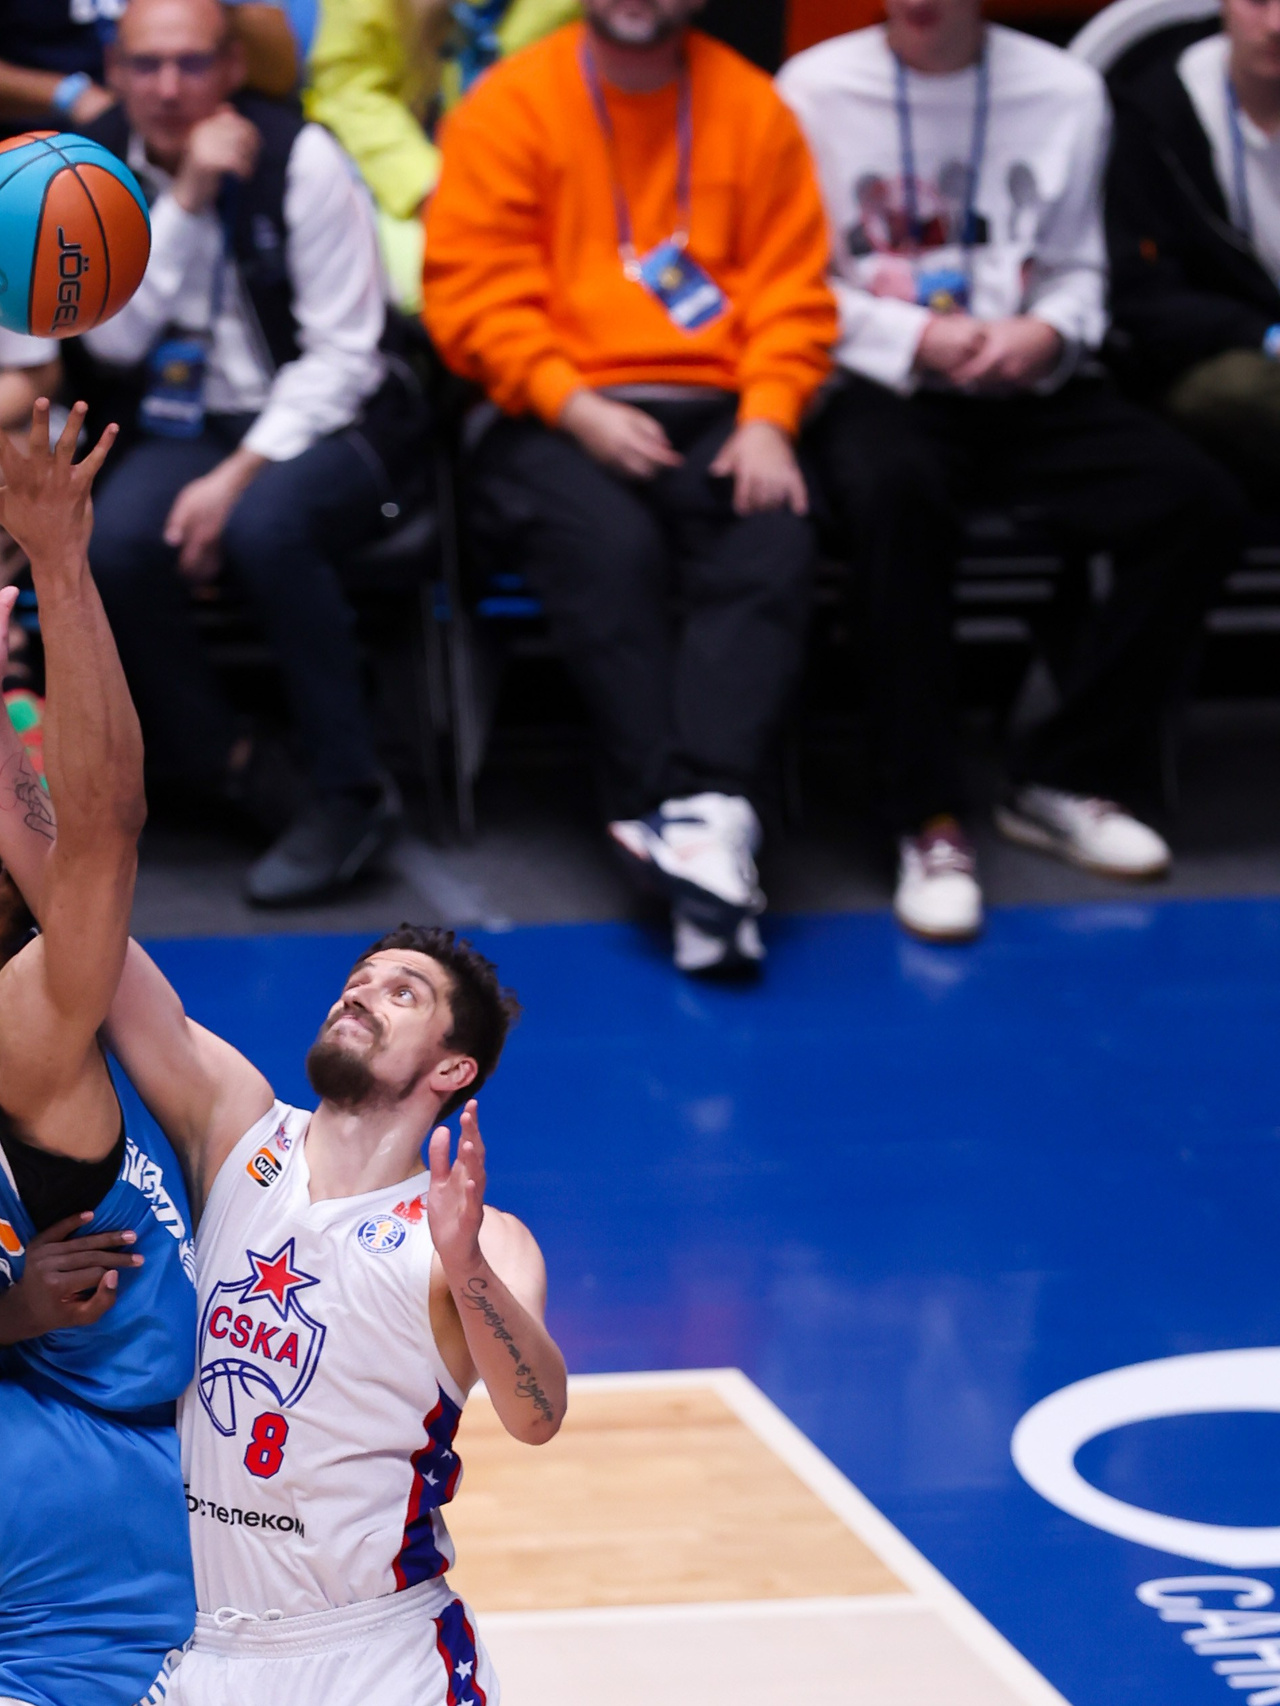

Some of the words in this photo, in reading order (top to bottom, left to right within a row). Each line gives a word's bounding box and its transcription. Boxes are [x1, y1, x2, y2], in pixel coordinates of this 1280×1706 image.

[257, 1157, 278, 1184] Win
[209, 1305, 299, 1369] CSKA
[243, 1411, 289, 1479] 8
